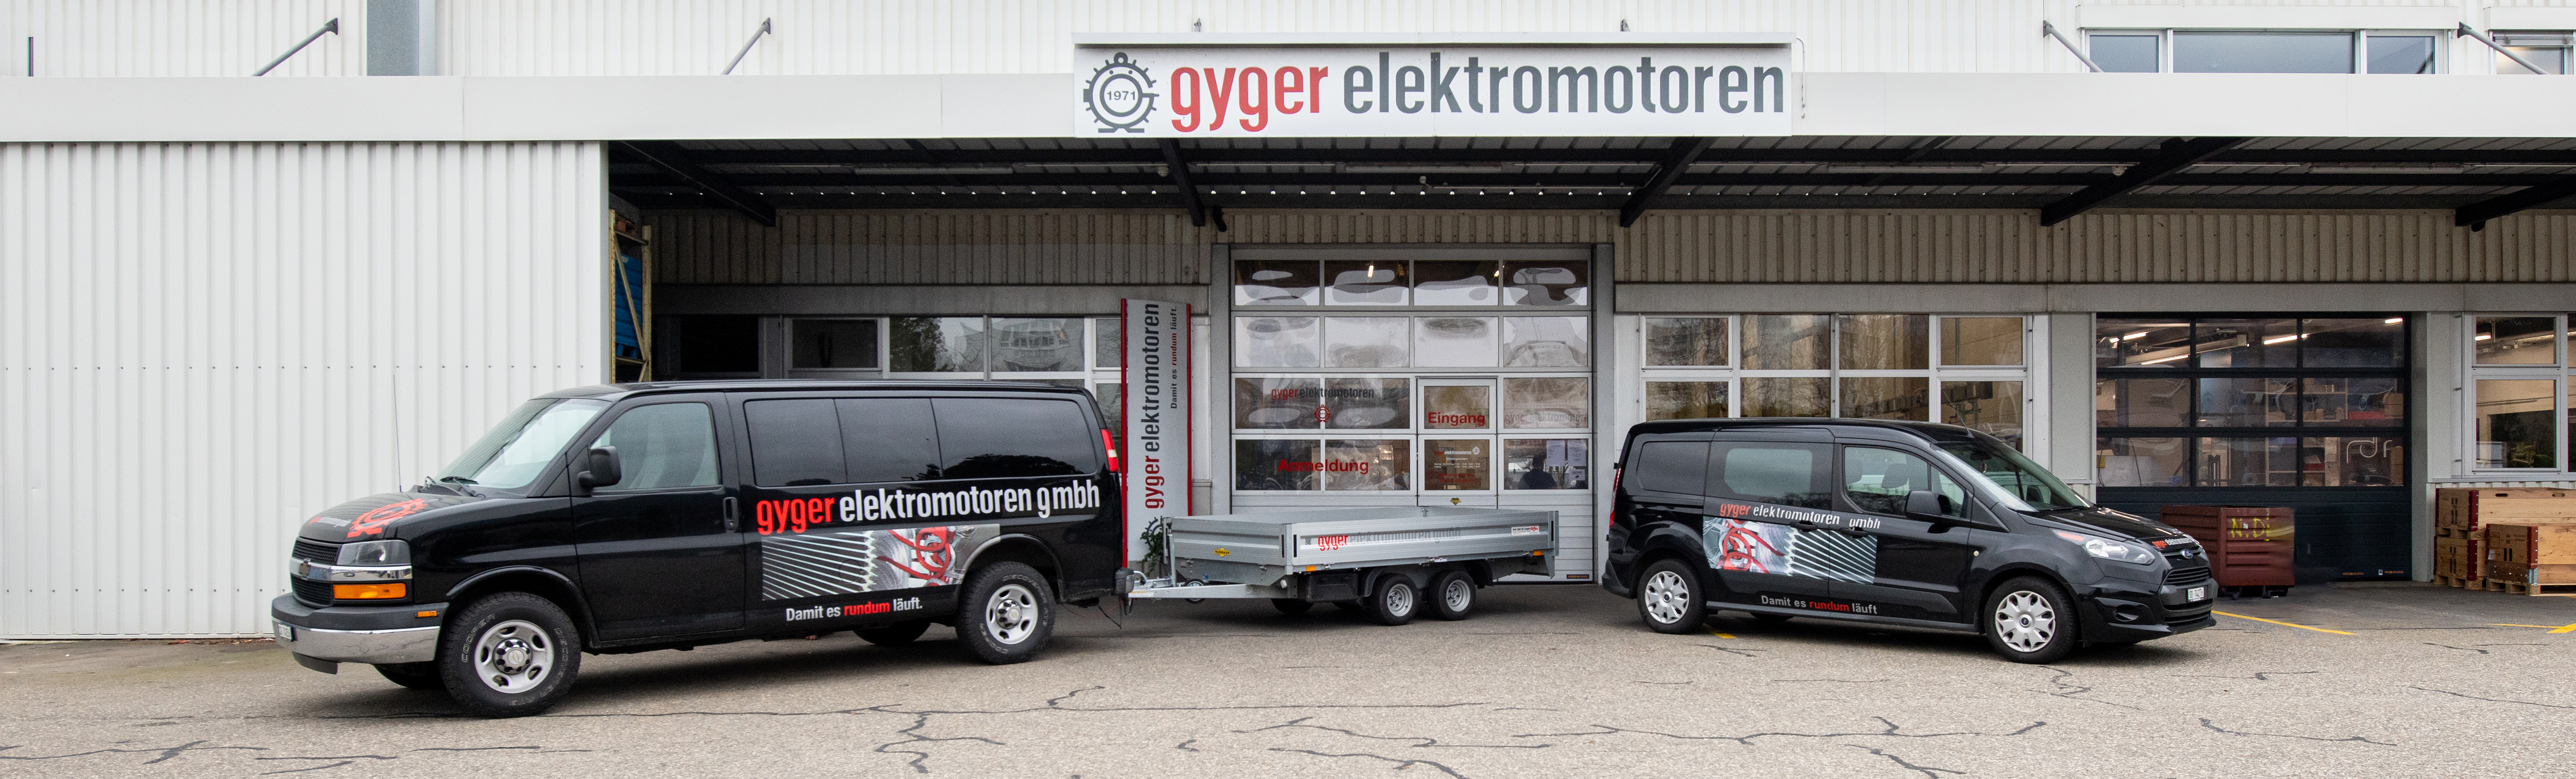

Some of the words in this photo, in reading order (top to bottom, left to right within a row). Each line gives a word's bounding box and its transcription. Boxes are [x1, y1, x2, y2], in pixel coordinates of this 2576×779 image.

[1107, 91, 1136, 100] 1971
[1171, 66, 1328, 132] gyger
[1344, 51, 1783, 114] elektromotoren
[1141, 303, 1160, 452] elektromotoren
[1172, 369, 1177, 379] es
[1271, 388, 1298, 401] gyger
[1300, 387, 1375, 398] elektromotoren
[1428, 412, 1485, 426] Eingang
[1277, 459, 1369, 475] Anmeldung
[1145, 455, 1164, 509] gyger
[756, 496, 835, 535] gyger
[839, 485, 1032, 522] elektromotoren
[1037, 479, 1100, 518] gmbh
[1720, 503, 1751, 517] gyger
[1753, 505, 1840, 525] elektromotoren
[1317, 534, 1349, 551] gyger
[786, 606, 823, 621] Damit
[826, 607, 841, 618] es
[844, 601, 890, 616] rundum
[893, 597, 923, 612] läuft.
[1761, 595, 1791, 607] Damit
[1809, 601, 1850, 612] rundum
[1852, 603, 1878, 614] läuft
